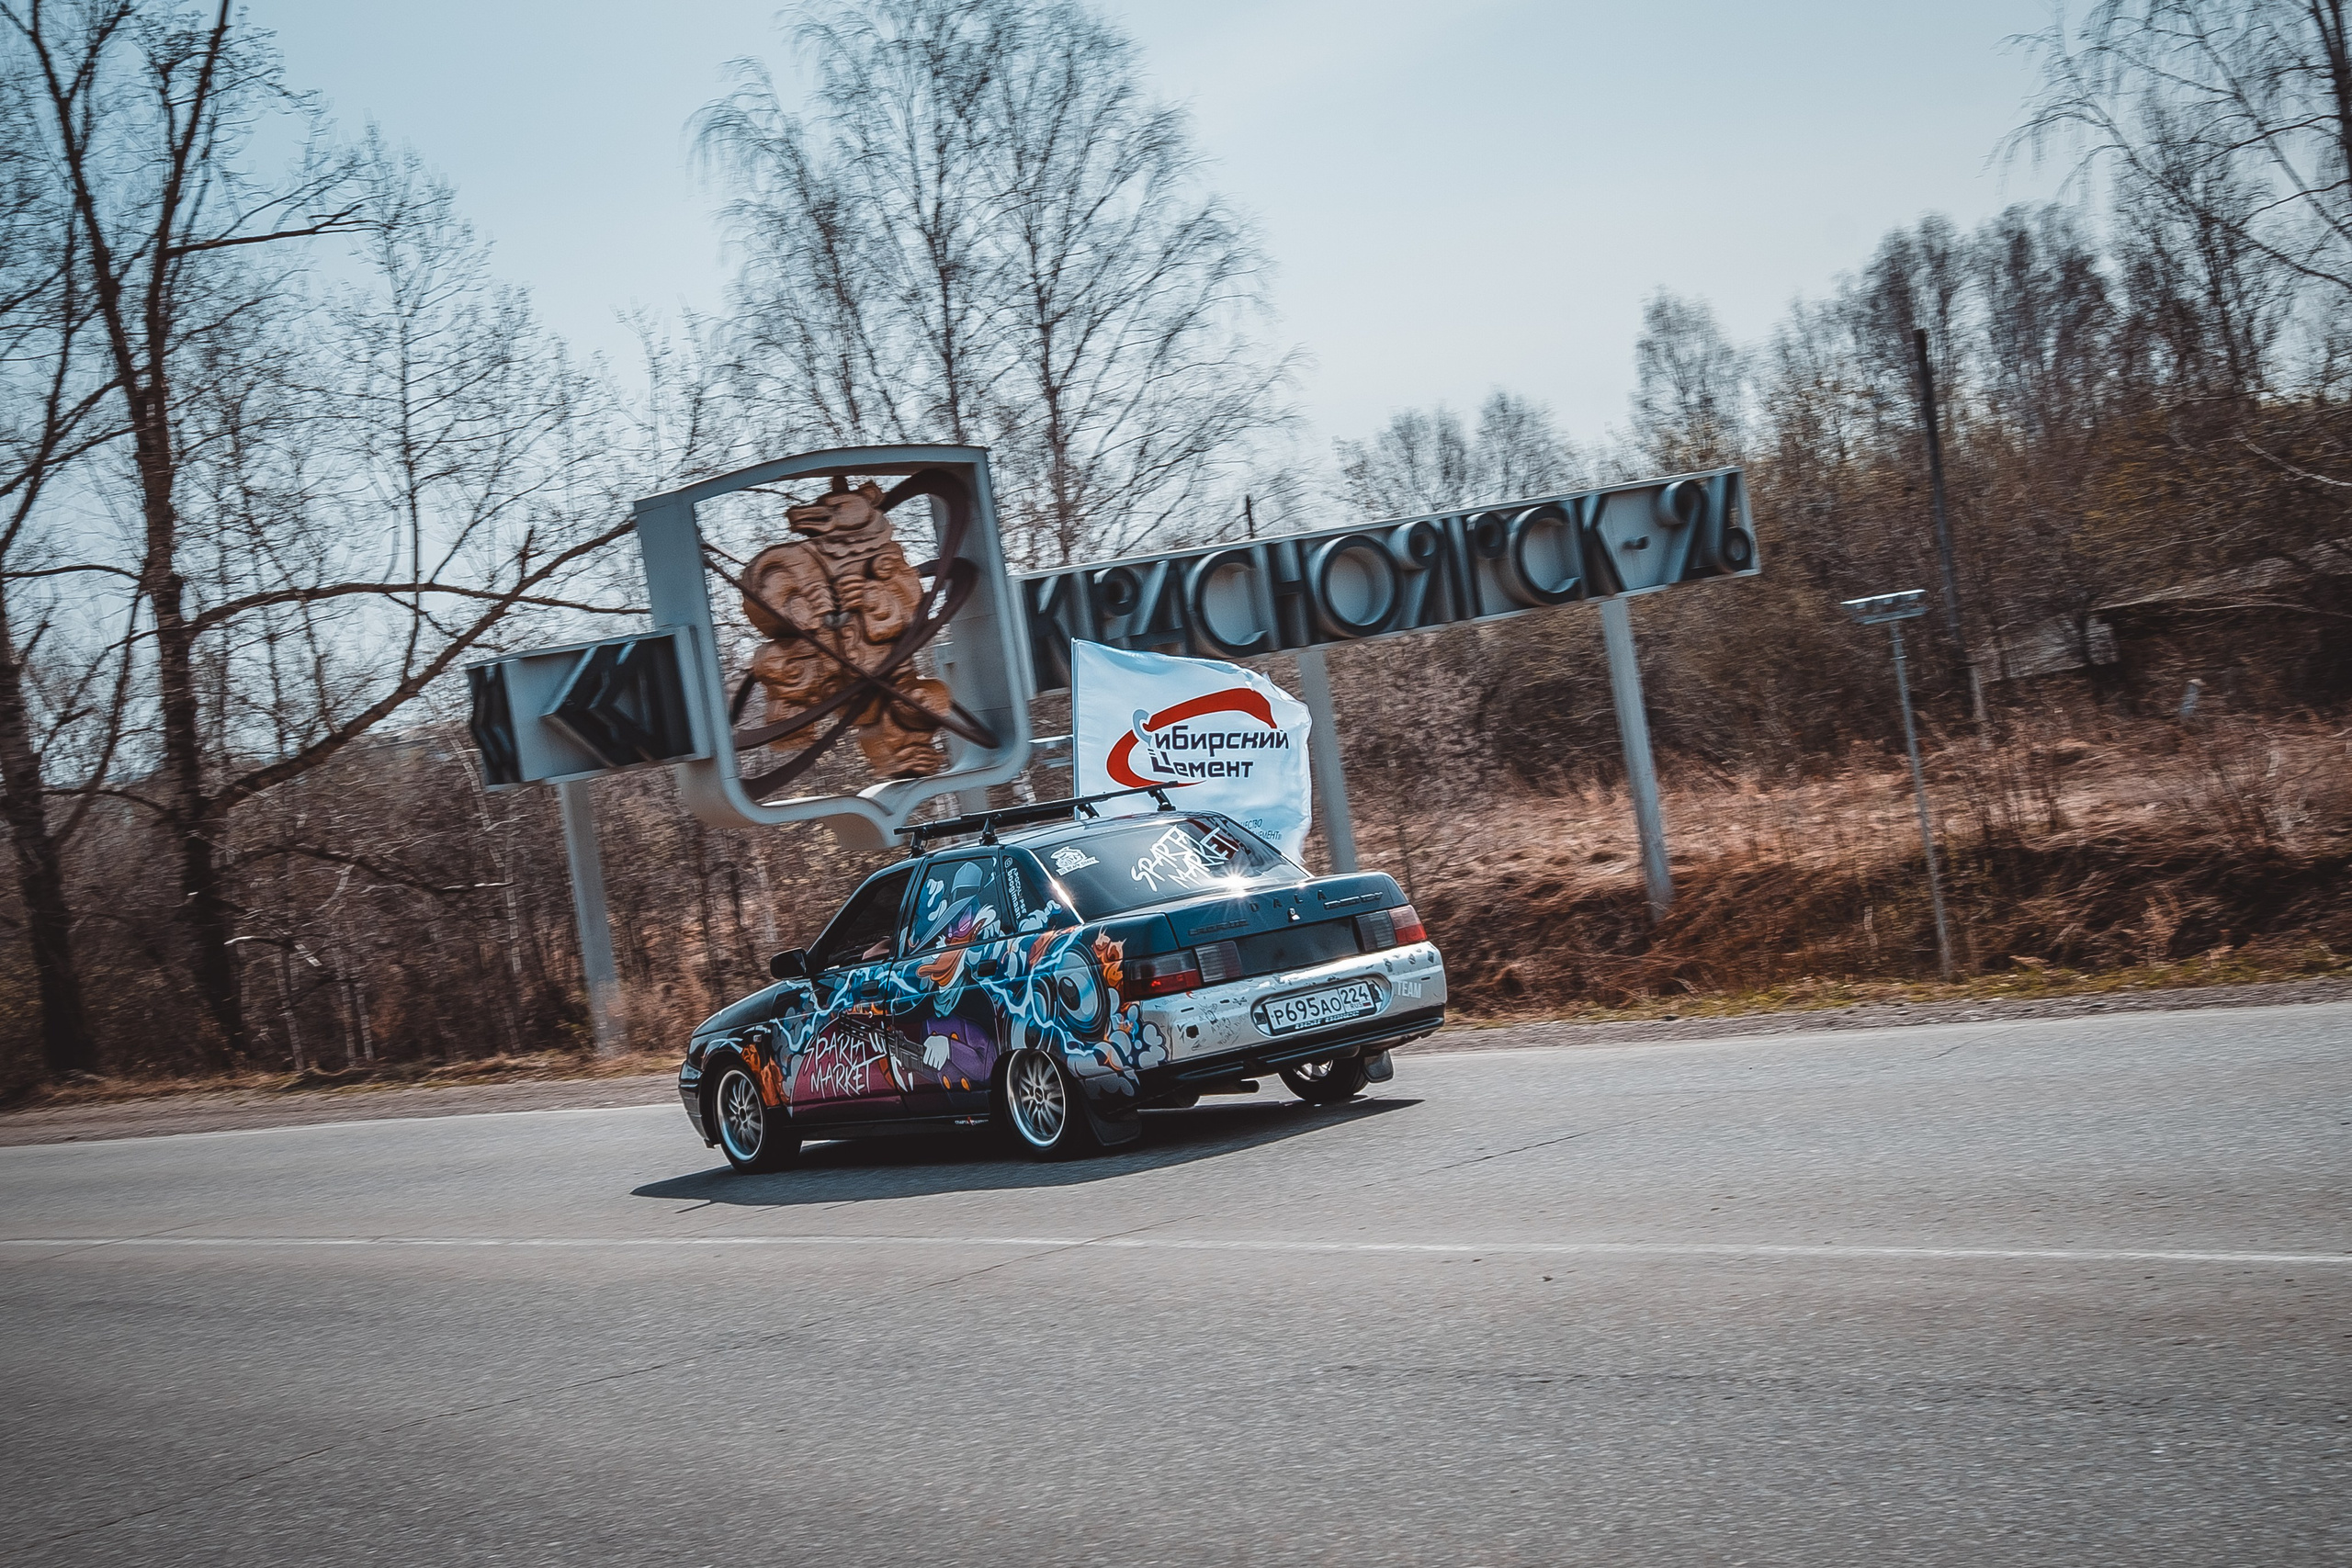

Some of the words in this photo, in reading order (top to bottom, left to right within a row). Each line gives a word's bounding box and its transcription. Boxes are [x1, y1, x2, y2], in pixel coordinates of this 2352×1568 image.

[1148, 748, 1254, 778] Цемент
[1131, 824, 1204, 892] SPARTA
[1168, 826, 1239, 890] MARKET
[1340, 986, 1369, 1005] 224
[1396, 980, 1422, 998] TEAM
[803, 1032, 867, 1073] SPARTA
[810, 1054, 887, 1100] MARKET
